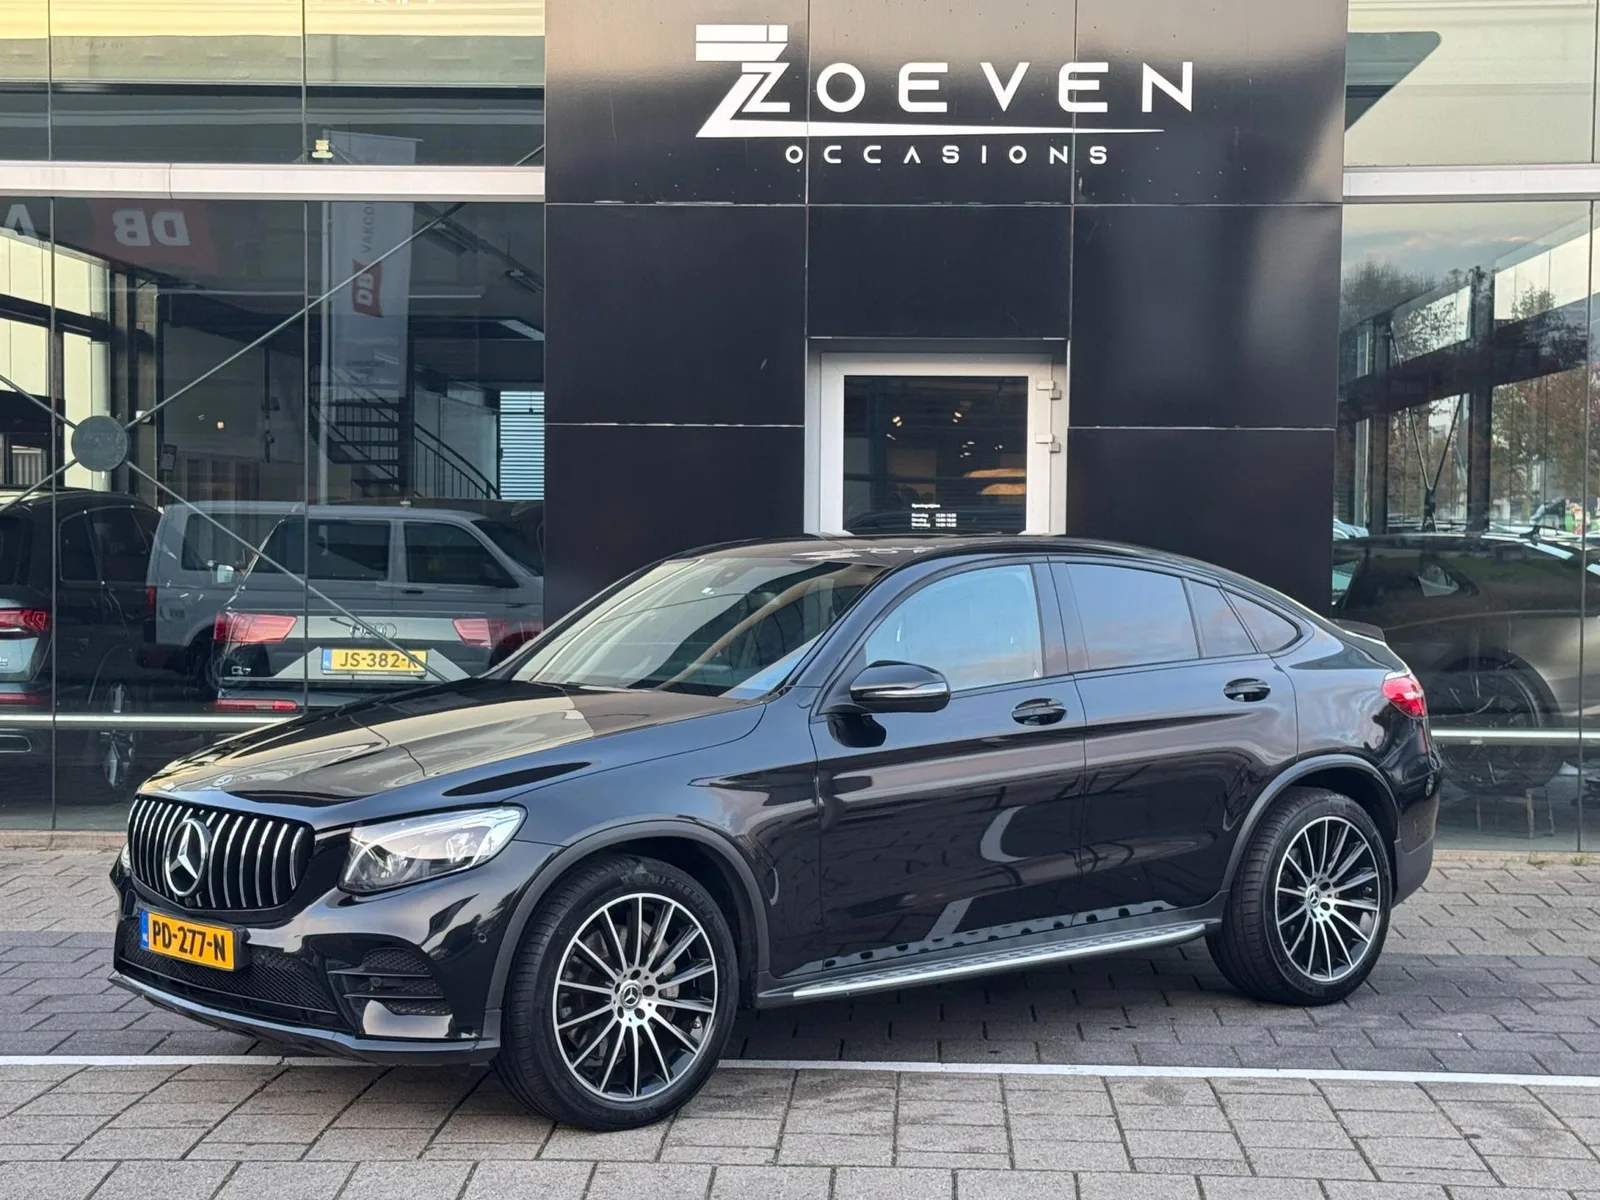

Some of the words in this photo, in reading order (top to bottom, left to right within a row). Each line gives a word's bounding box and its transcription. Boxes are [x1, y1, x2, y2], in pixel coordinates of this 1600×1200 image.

[785, 145, 1108, 164] OCCASIONS
[361, 201, 376, 254] VAKCO
[152, 919, 226, 963] PD-277-N
